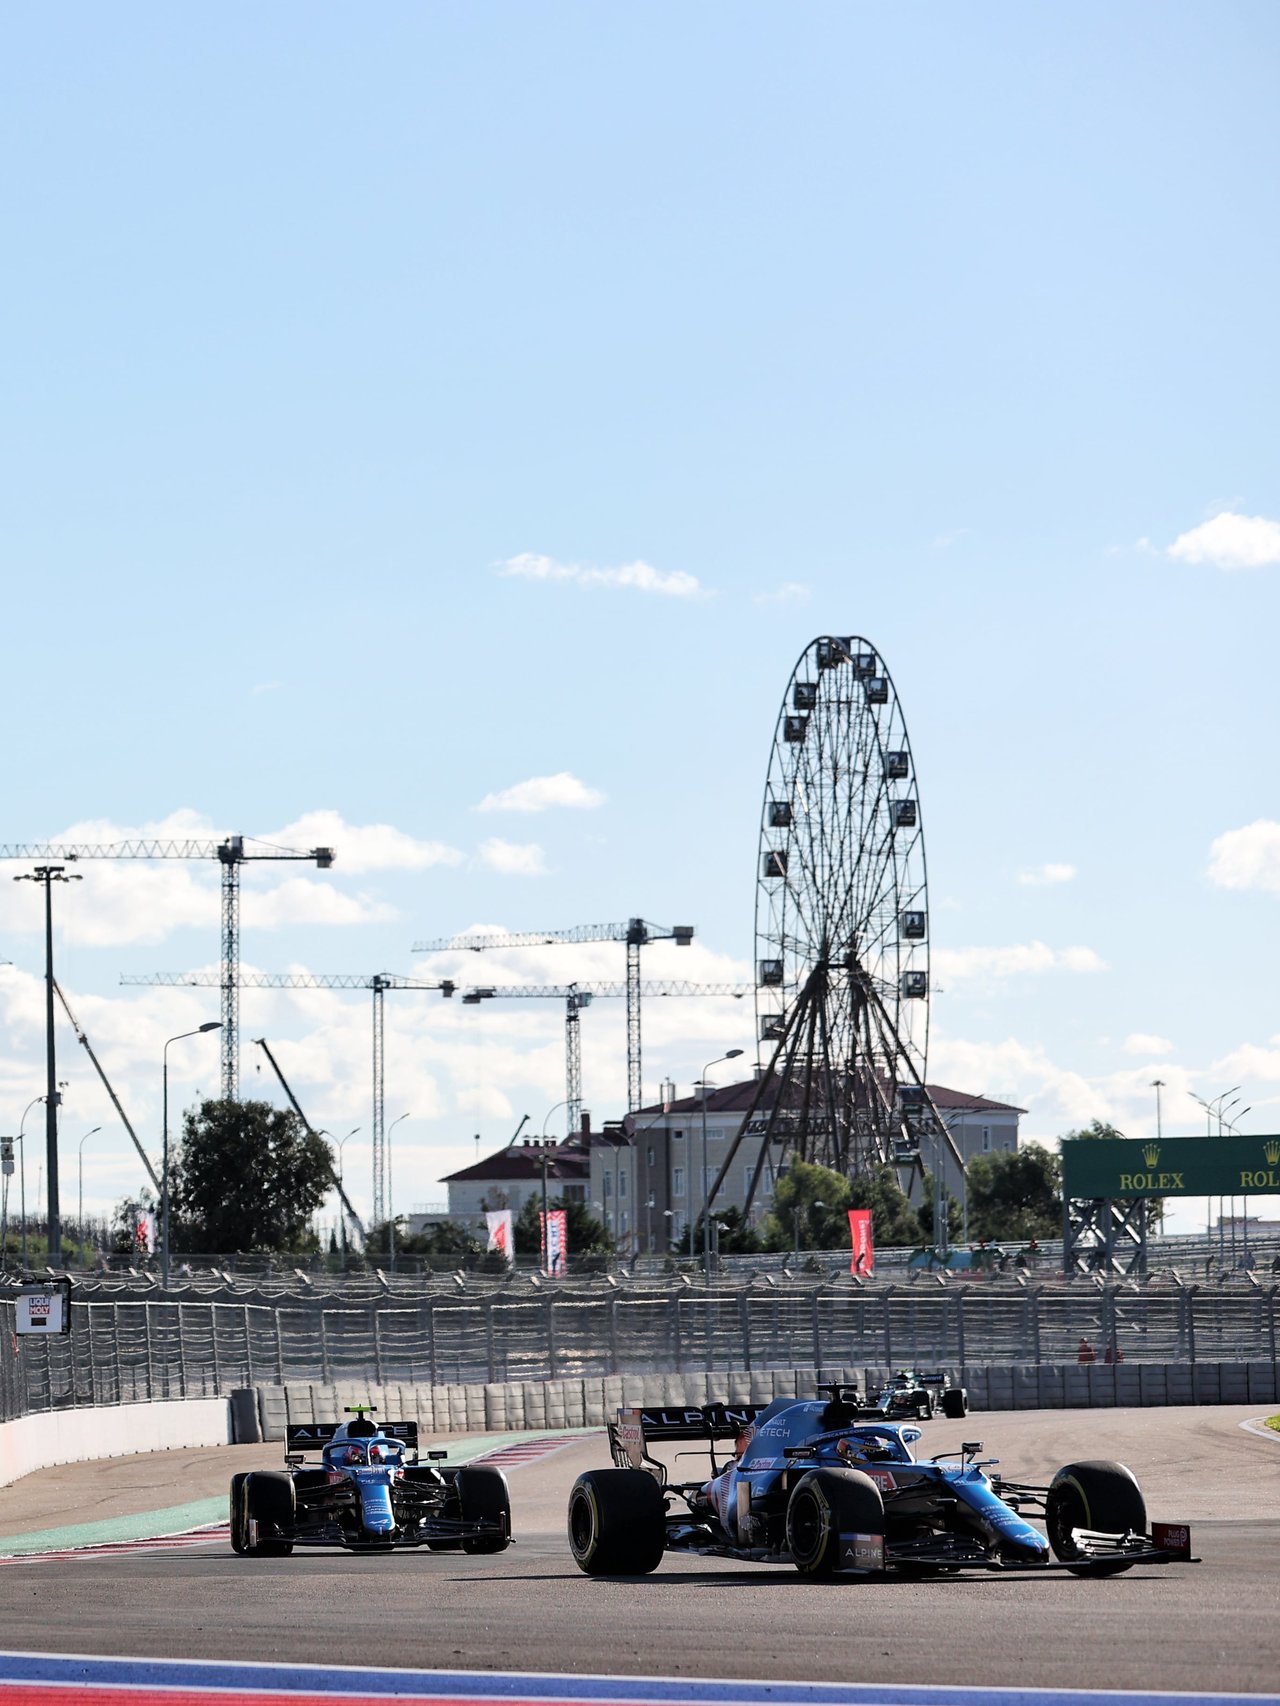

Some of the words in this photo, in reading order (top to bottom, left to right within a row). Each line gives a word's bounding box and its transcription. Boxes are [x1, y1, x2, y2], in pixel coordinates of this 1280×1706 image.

[1120, 1173, 1185, 1189] ROLEX
[1240, 1171, 1280, 1188] ROL
[29, 1298, 50, 1306] LIQUI
[29, 1306, 50, 1314] MOLY
[845, 1548, 882, 1558] ALPINE
